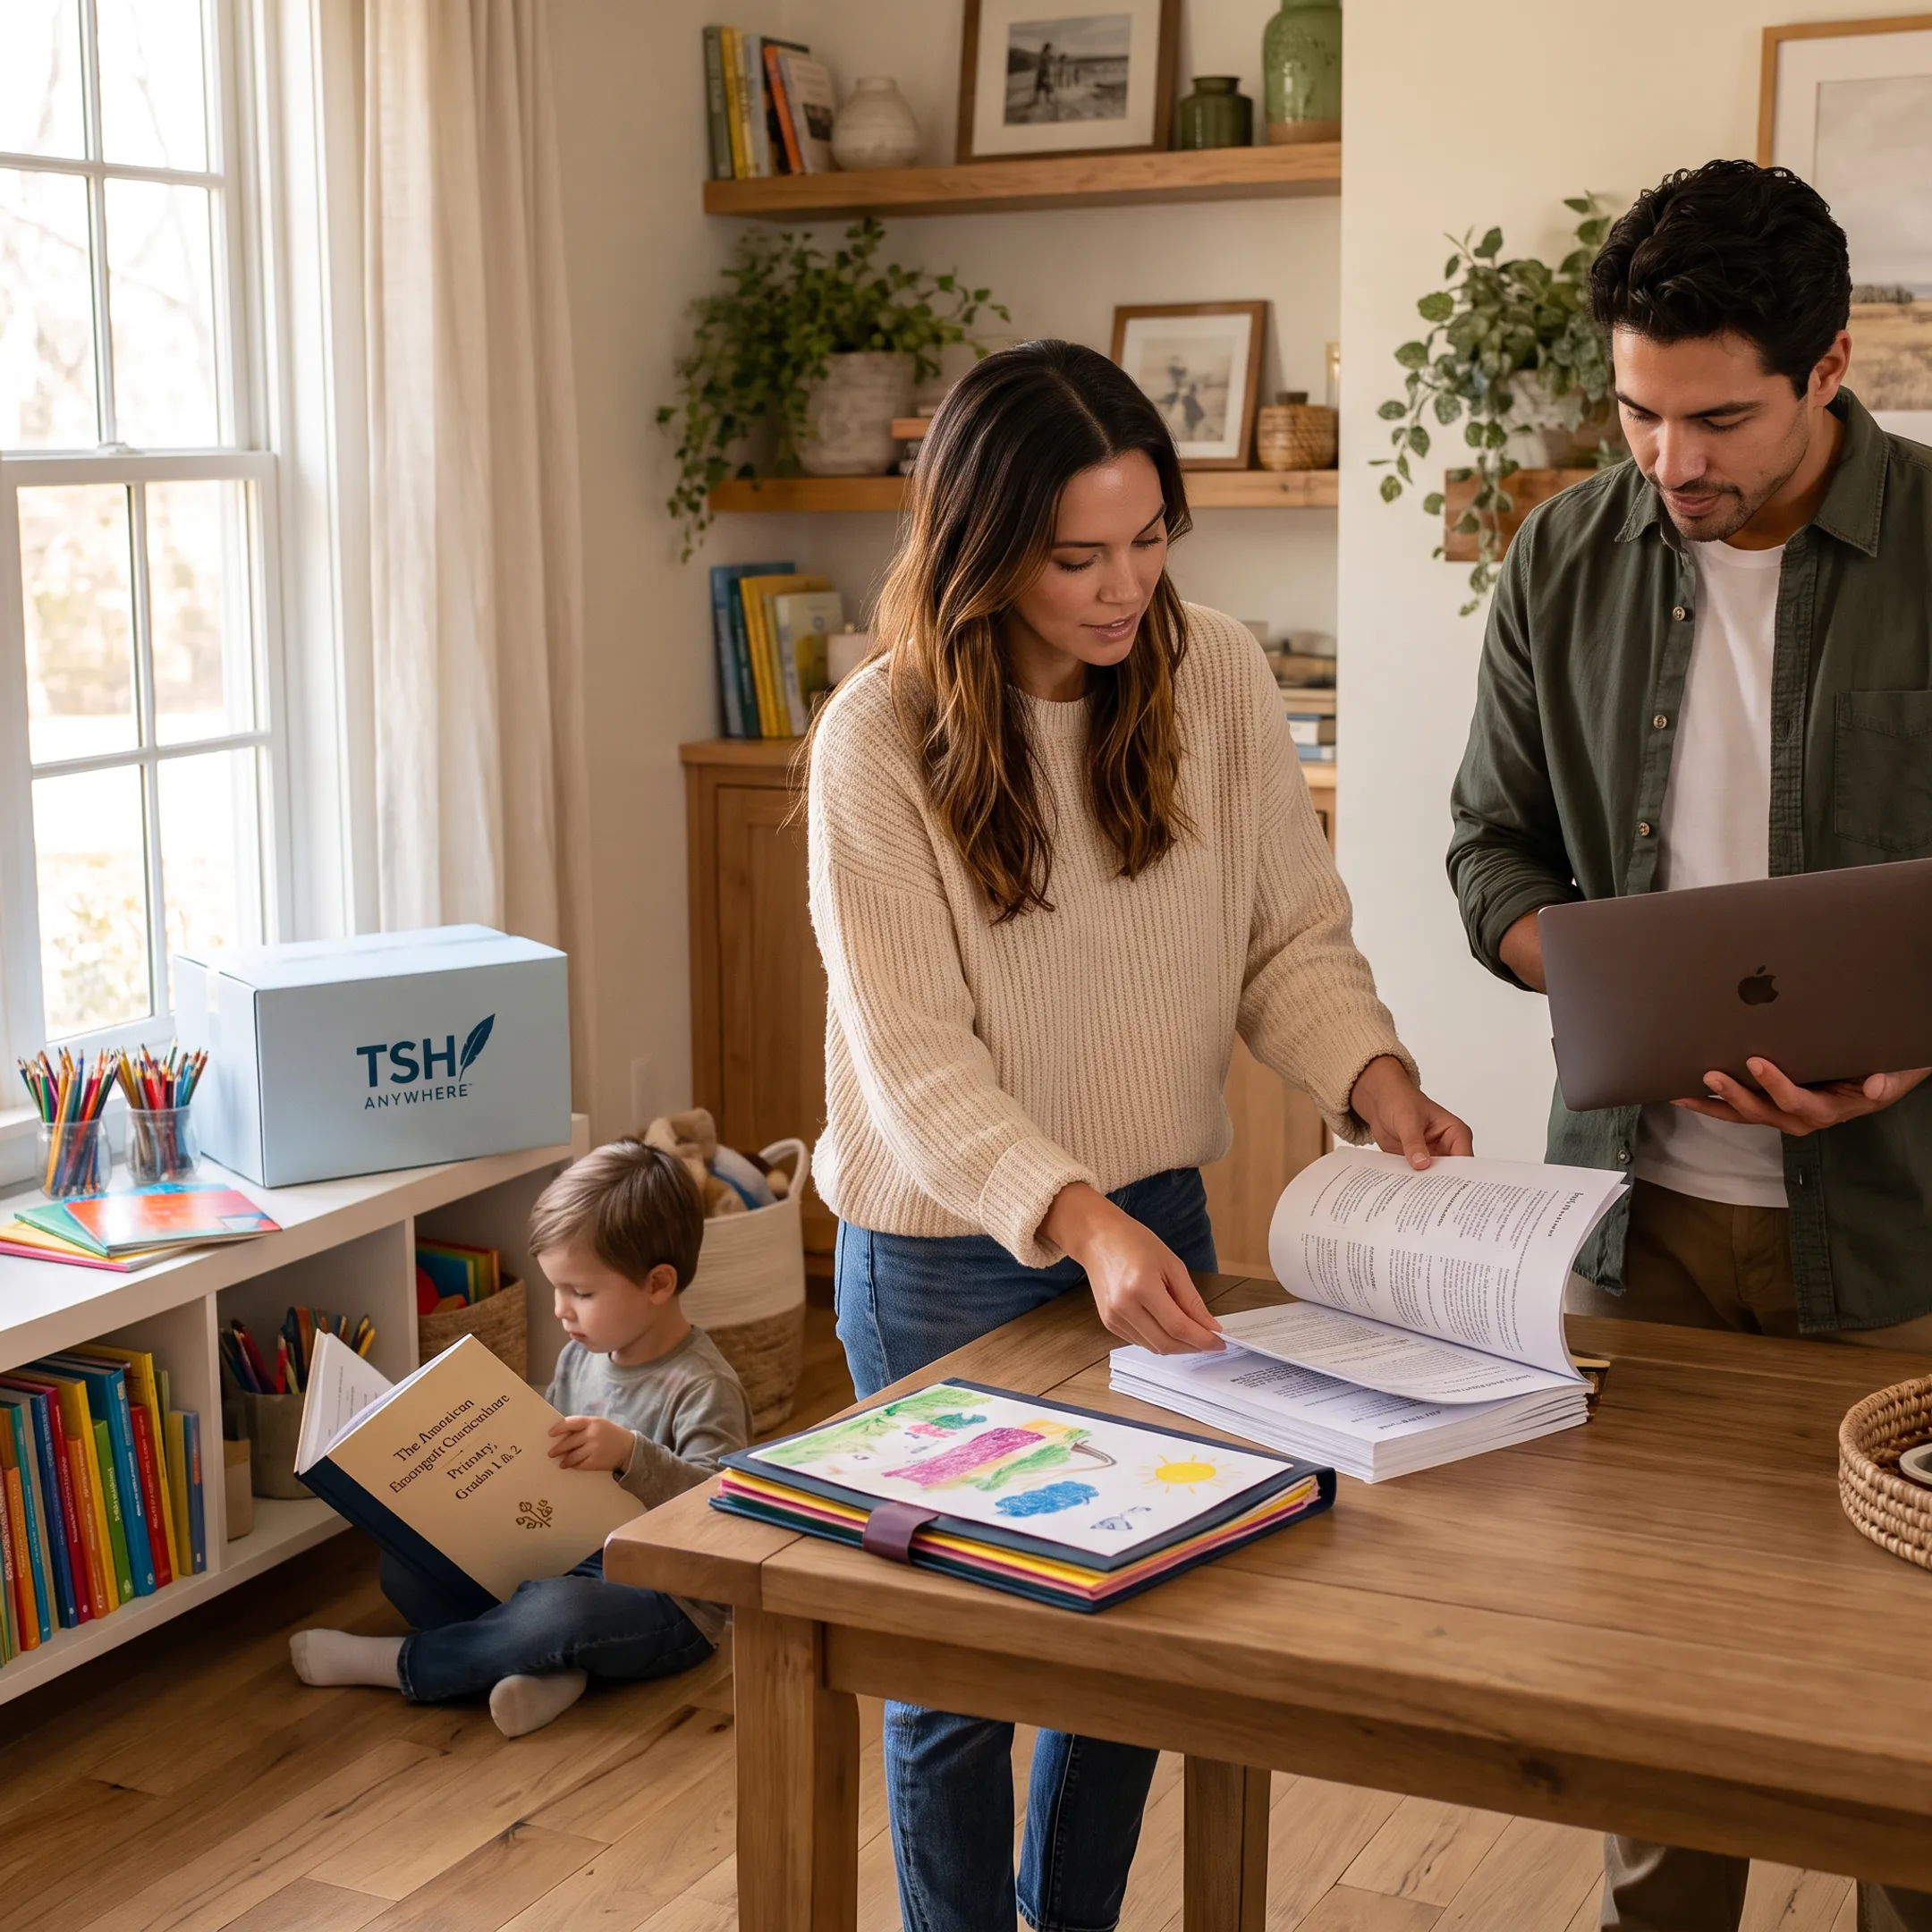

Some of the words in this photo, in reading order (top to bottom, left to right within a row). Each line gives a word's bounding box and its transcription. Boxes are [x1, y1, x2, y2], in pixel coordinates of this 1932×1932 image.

[356, 1035, 456, 1088] TSH
[393, 1442, 421, 1462] The
[510, 1445, 522, 1455] 2
